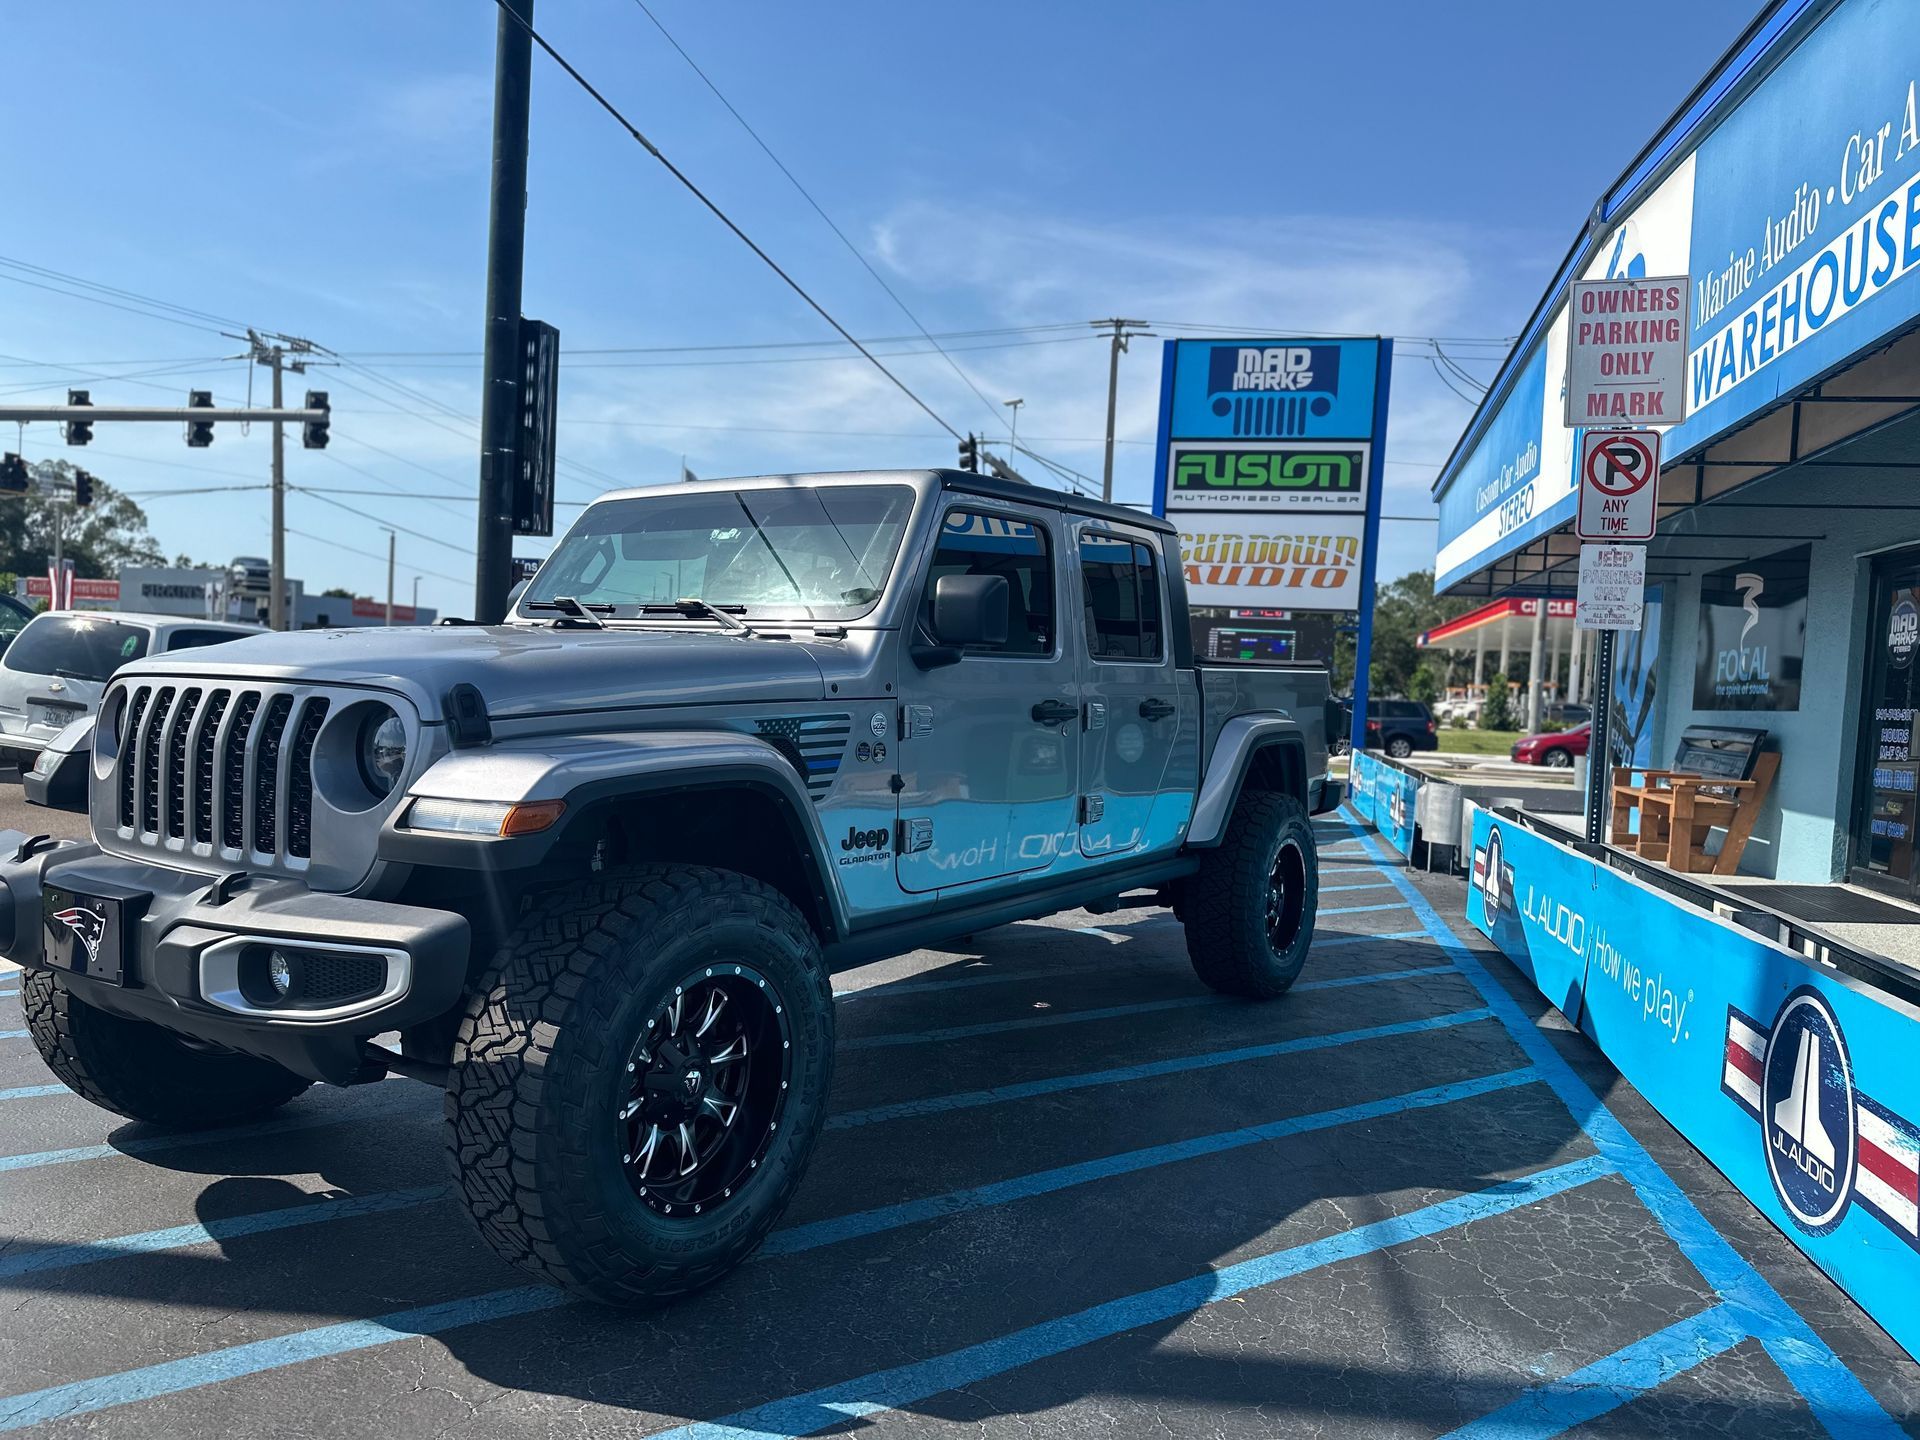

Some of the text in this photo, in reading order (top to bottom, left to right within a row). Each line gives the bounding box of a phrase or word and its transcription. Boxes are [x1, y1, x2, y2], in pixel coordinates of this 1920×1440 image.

[1695, 247, 1755, 331] Marine
[1758, 181, 1820, 279] Audio
[1840, 121, 1891, 205] Car
[1581, 287, 1680, 315] OWNERS
[1693, 179, 1920, 409] WAREHOUSE
[1578, 318, 1680, 346] PARKING
[1237, 347, 1312, 373] MAD
[1600, 351, 1655, 376] ONLY
[1232, 371, 1314, 391] MARKS
[1586, 391, 1665, 417] MARK
[1176, 454, 1352, 487] FUSION
[1475, 440, 1538, 514] Custom Car Audio
[1173, 494, 1360, 503] AUTHORIZED DEALER
[1498, 482, 1536, 538] STEREO
[1602, 499, 1629, 513] ANY
[1600, 516, 1630, 531] TIME
[1183, 564, 1349, 589] AUDIO
[1521, 601, 1575, 615] CICLE
[1890, 613, 1918, 632] MAD
[1888, 630, 1918, 647] MARKS
[1716, 645, 1770, 683] FOCAL
[1716, 681, 1769, 698] the spirit of sound
[1881, 727, 1910, 744] HOURS
[1873, 767, 1915, 791] SUB BOX
[841, 827, 889, 851] Jeep
[839, 852, 891, 866] GLADIATOR
[1523, 884, 1537, 923] JL
[1537, 893, 1585, 957] AUDIO
[1594, 924, 1622, 982] How
[1622, 957, 1641, 1001] we
[1772, 1130, 1836, 1194] JL AUDIO
